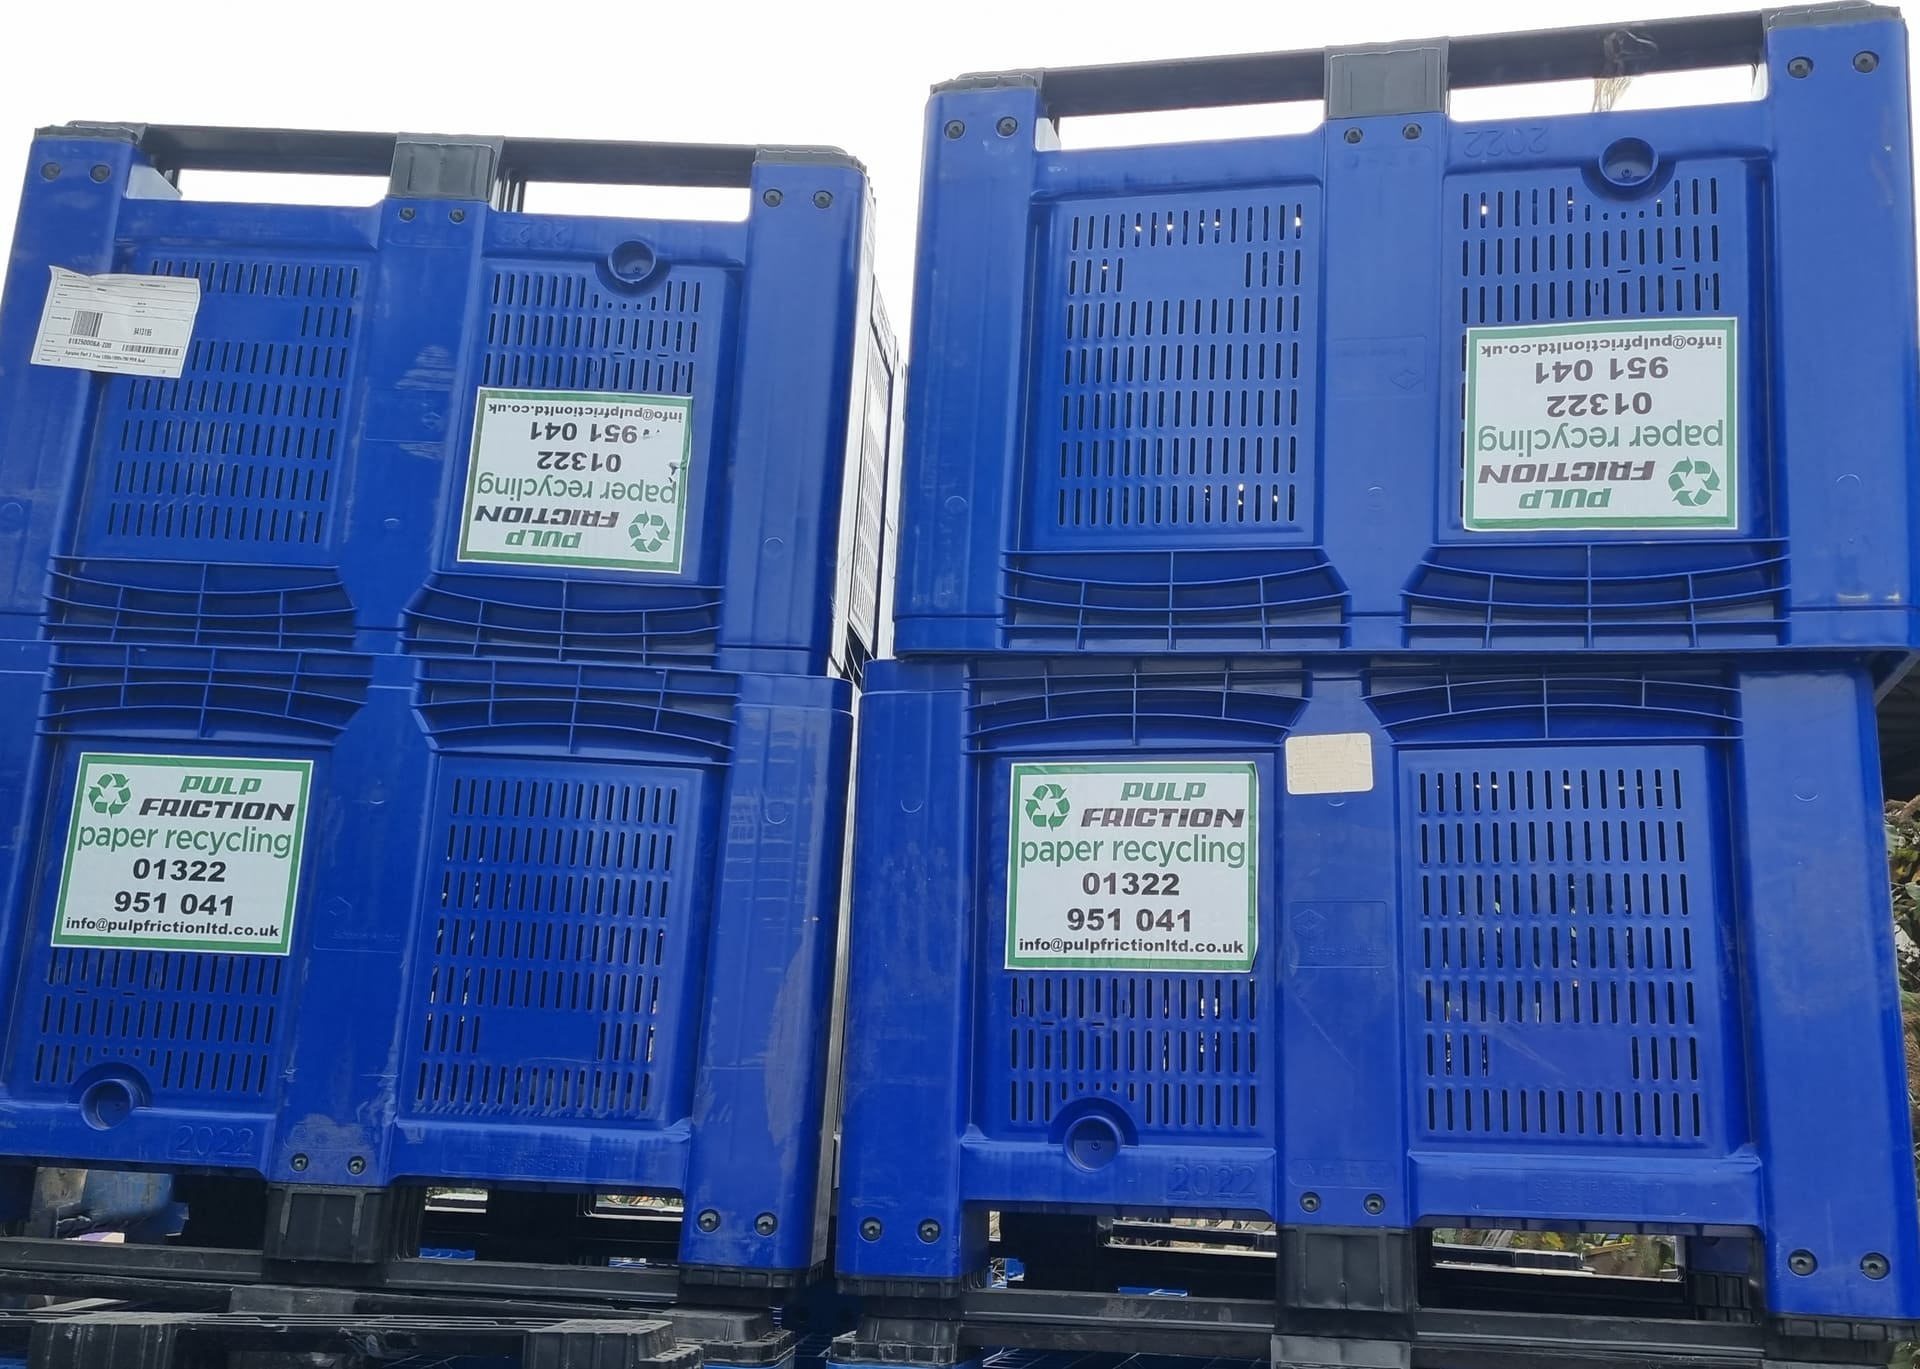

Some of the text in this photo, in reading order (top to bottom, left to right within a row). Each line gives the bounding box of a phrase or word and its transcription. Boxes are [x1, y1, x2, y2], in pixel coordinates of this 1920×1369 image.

[1481, 334, 1722, 357] info@pulpfrictionltd.co.uk
[1535, 356, 1668, 384] 951 041
[488, 403, 682, 423] info@pulpfrictionltd.co.uk
[1547, 392, 1652, 418] 01322
[530, 422, 638, 444] 951 041
[1478, 420, 1723, 457] paper recycling
[537, 451, 621, 472] 01322
[1478, 460, 1656, 484] FRICTION
[477, 472, 676, 505] paper recycling
[1519, 488, 1612, 509] PULP
[474, 506, 619, 528] FRICTION
[505, 530, 582, 549] PULP
[180, 775, 262, 795] PULP
[1120, 782, 1206, 801] PULP
[139, 798, 295, 821] FRICTION
[1081, 808, 1245, 828] FRICTION
[78, 826, 292, 858] paper recycling
[1021, 834, 1245, 868] paper recycling
[133, 858, 226, 882] 01322
[1082, 872, 1179, 896] 01322
[114, 891, 234, 916] 951 041
[66, 917, 279, 937] info@pulpfrictionltd.co.uk
[1067, 908, 1190, 932] 951 041
[1020, 938, 1243, 954] info@pulpfrictionltd.co.uk
